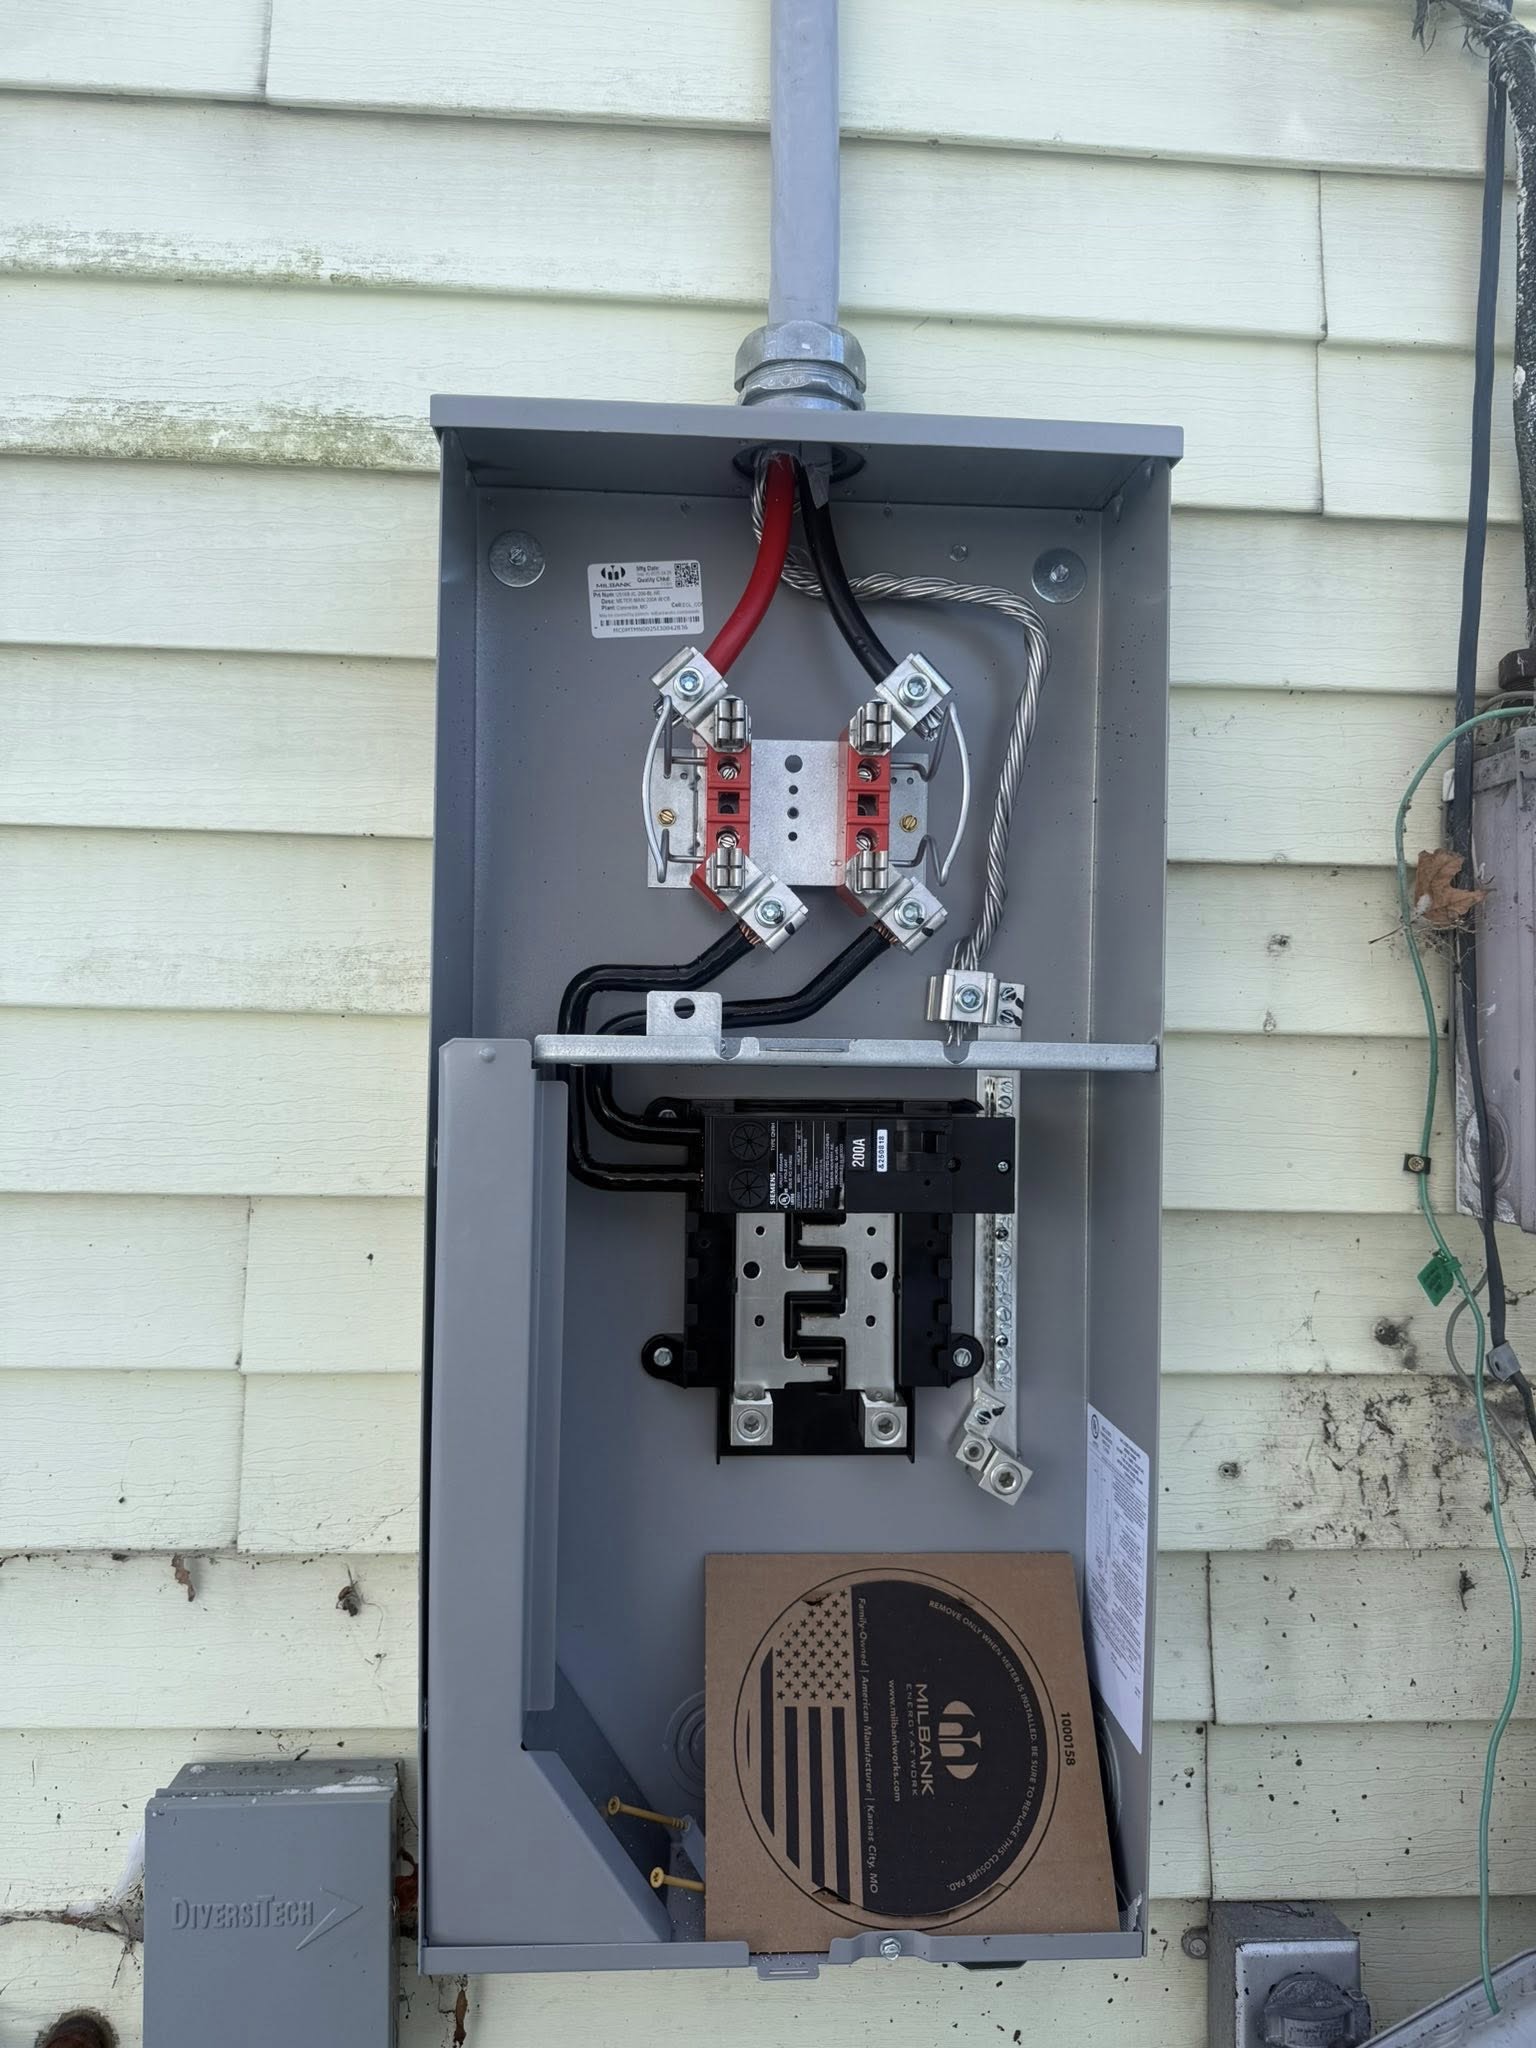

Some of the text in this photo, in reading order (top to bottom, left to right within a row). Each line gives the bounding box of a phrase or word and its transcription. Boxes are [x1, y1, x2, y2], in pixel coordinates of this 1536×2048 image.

[852, 1139, 865, 1167] 200A
[928, 1600, 962, 1620] REMOVE
[858, 1598, 869, 1666] Family-Owned
[962, 1618, 983, 1635] ONLY
[982, 1633, 1002, 1656] WHEN
[1001, 1656, 1021, 1682] METER
[862, 1676, 871, 1722] American
[1017, 1683, 1024, 1693] IS
[906, 1683, 915, 1736] ENERGY
[888, 1680, 901, 1802] www.milbankworks.com
[909, 1740, 916, 1755] AT
[915, 1684, 935, 1796] MILBANK
[1031, 1746, 1039, 1756] BE
[1061, 1712, 1075, 1765] 1000158
[864, 1726, 873, 1794] Manufacturer
[1030, 1762, 1039, 1783] SURE
[1026, 1786, 1036, 1797] TO
[864, 1805, 876, 1842] Kansas
[1011, 1799, 1032, 1837] REPLACE
[998, 1837, 1014, 1855] THIS
[966, 1854, 999, 1883] CLOSURE
[870, 1873, 878, 1893] MO
[946, 1879, 966, 1891] PAD.
